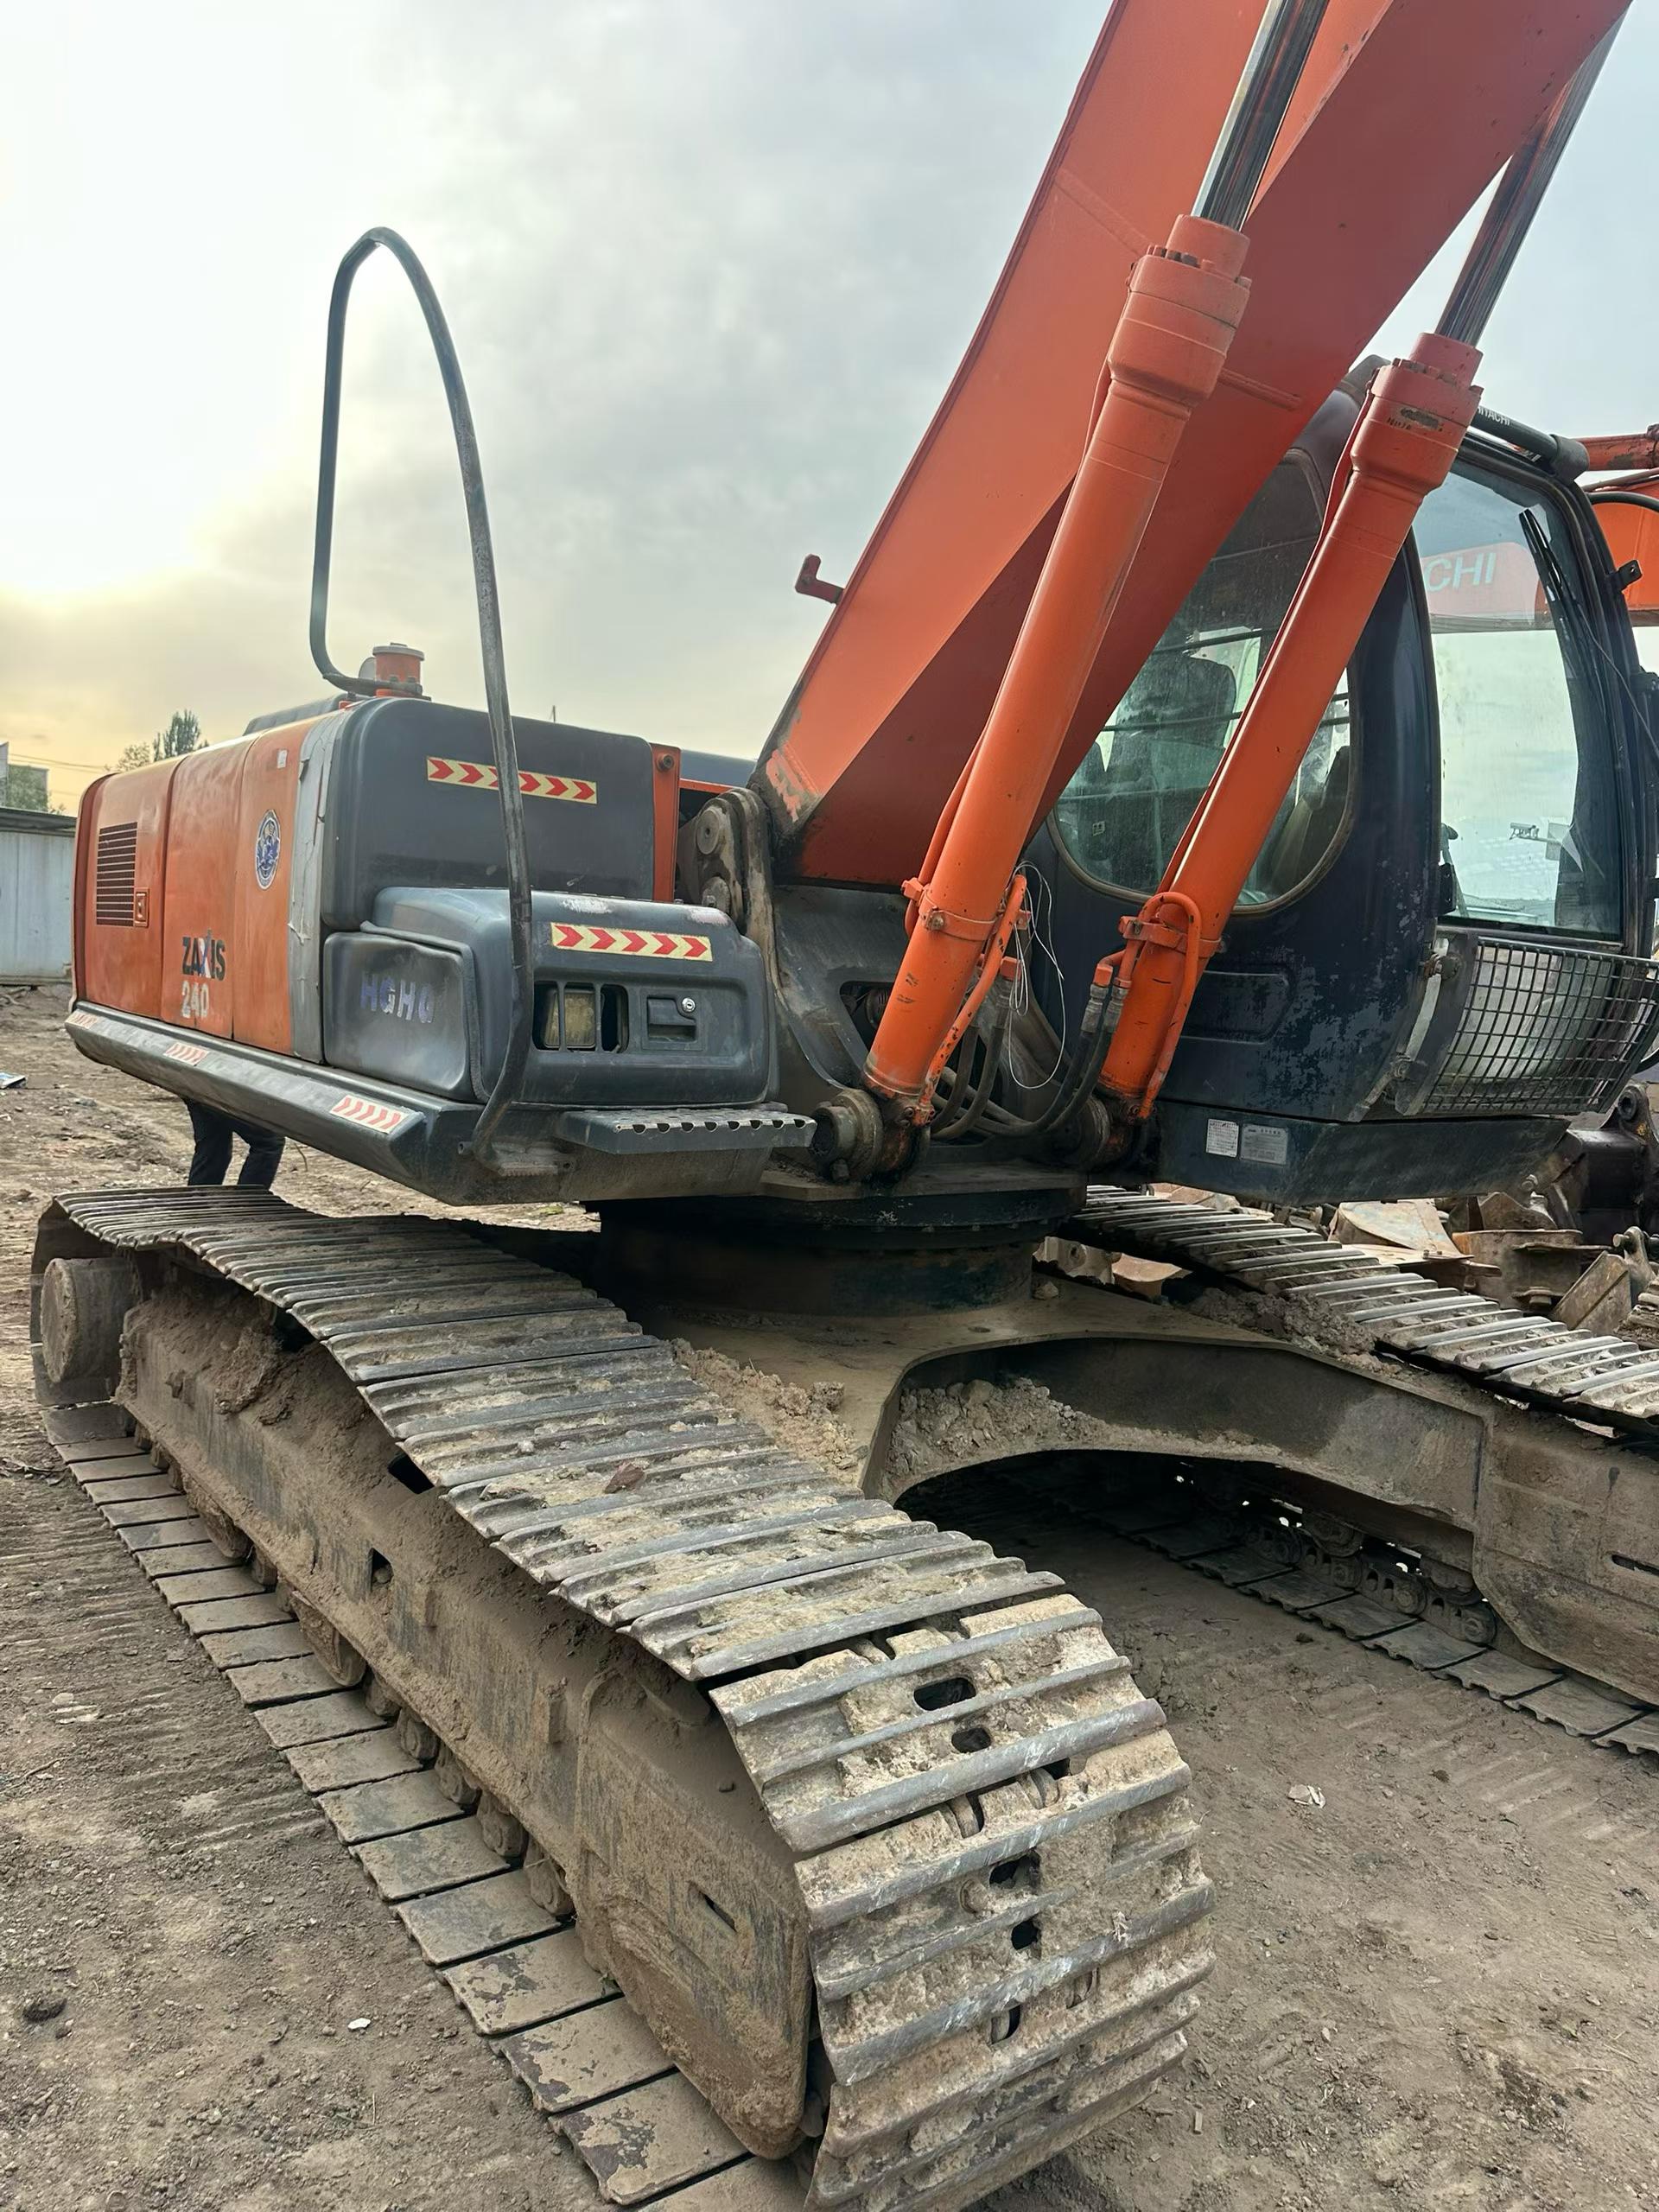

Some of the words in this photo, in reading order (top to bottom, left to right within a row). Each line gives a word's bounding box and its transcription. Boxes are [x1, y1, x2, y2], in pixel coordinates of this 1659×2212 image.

[1424, 552, 1497, 592] CHI
[182, 928, 226, 982] ZAXIS
[181, 980, 210, 1019] 240
